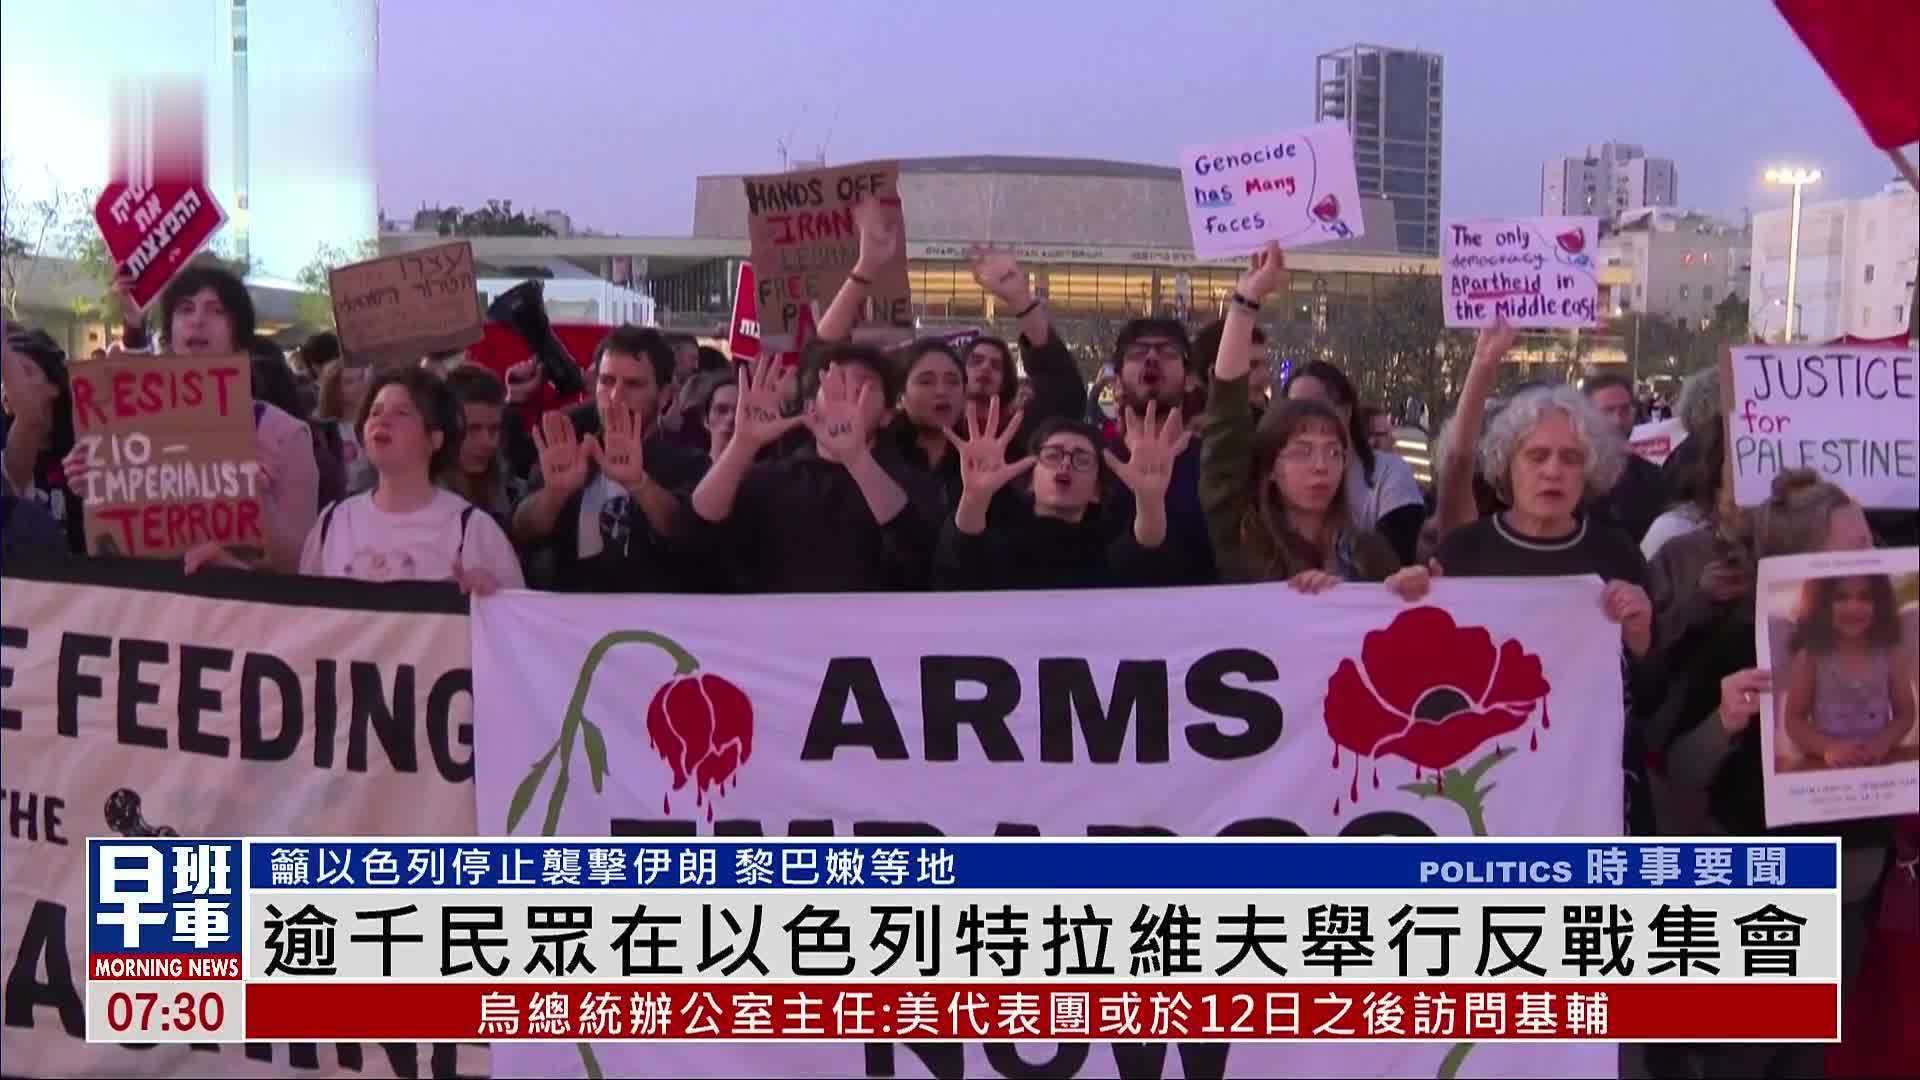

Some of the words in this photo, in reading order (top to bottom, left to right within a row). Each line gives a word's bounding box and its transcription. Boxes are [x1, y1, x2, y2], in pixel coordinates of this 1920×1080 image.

[1195, 143, 1296, 176] Genocide
[745, 177, 824, 217] HANDS
[837, 172, 887, 202] OFF
[1195, 184, 1232, 204] has
[1246, 175, 1295, 196] Many
[767, 207, 854, 245] IRAN
[1453, 225, 1482, 247] The
[1496, 224, 1530, 249] only
[1450, 252, 1546, 271] democracy
[1556, 274, 1575, 291] in
[1455, 300, 1486, 320] the
[1744, 354, 1915, 401] JUSTICE
[72, 367, 239, 431] RESIST
[1740, 399, 1792, 434] for
[1735, 436, 1916, 479] PALESTINE
[83, 463, 257, 505] IMPERIALIST
[97, 501, 265, 556] TERROR
[56, 631, 475, 784] FEEDING
[800, 648, 1283, 764] ARMS
[0, 789, 69, 846] HE
